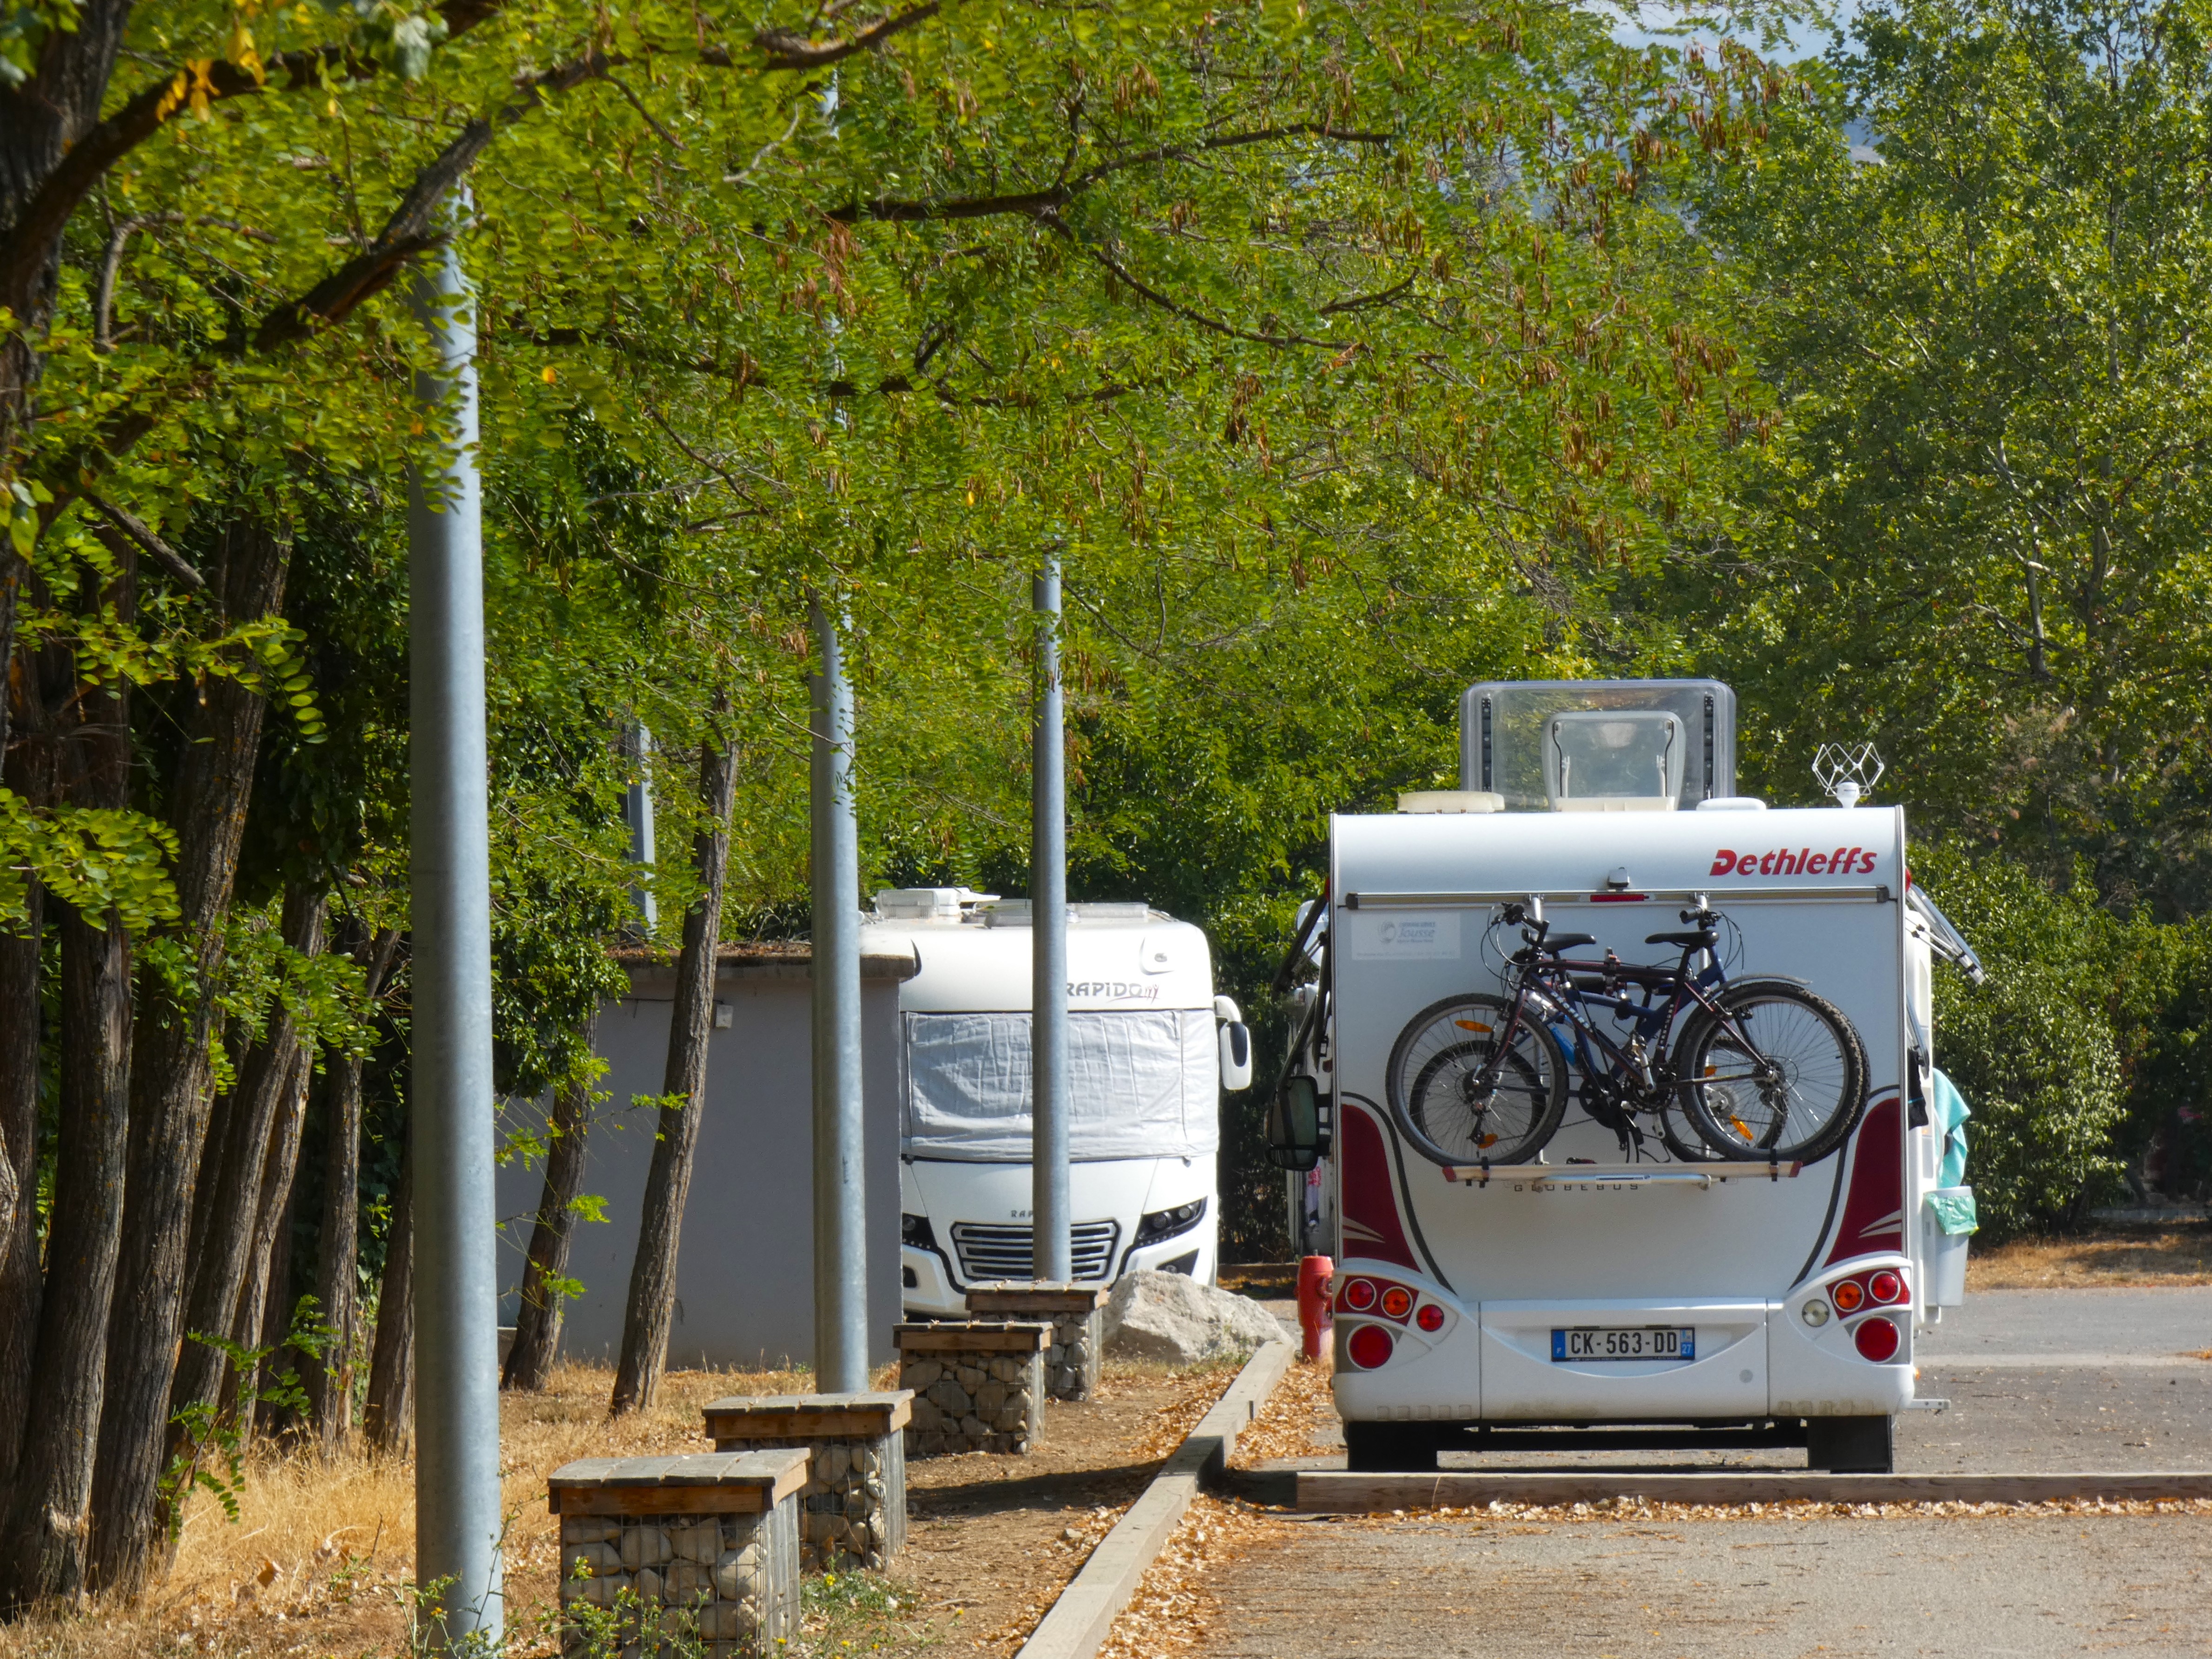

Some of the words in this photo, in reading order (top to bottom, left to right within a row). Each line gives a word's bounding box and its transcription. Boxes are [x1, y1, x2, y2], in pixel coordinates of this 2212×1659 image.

[1709, 847, 1877, 876] Dethleffs
[1066, 982, 1142, 998] RAPIDO
[1570, 1331, 1677, 1354] CK-563-DD
[1681, 1343, 1692, 1354] 27
